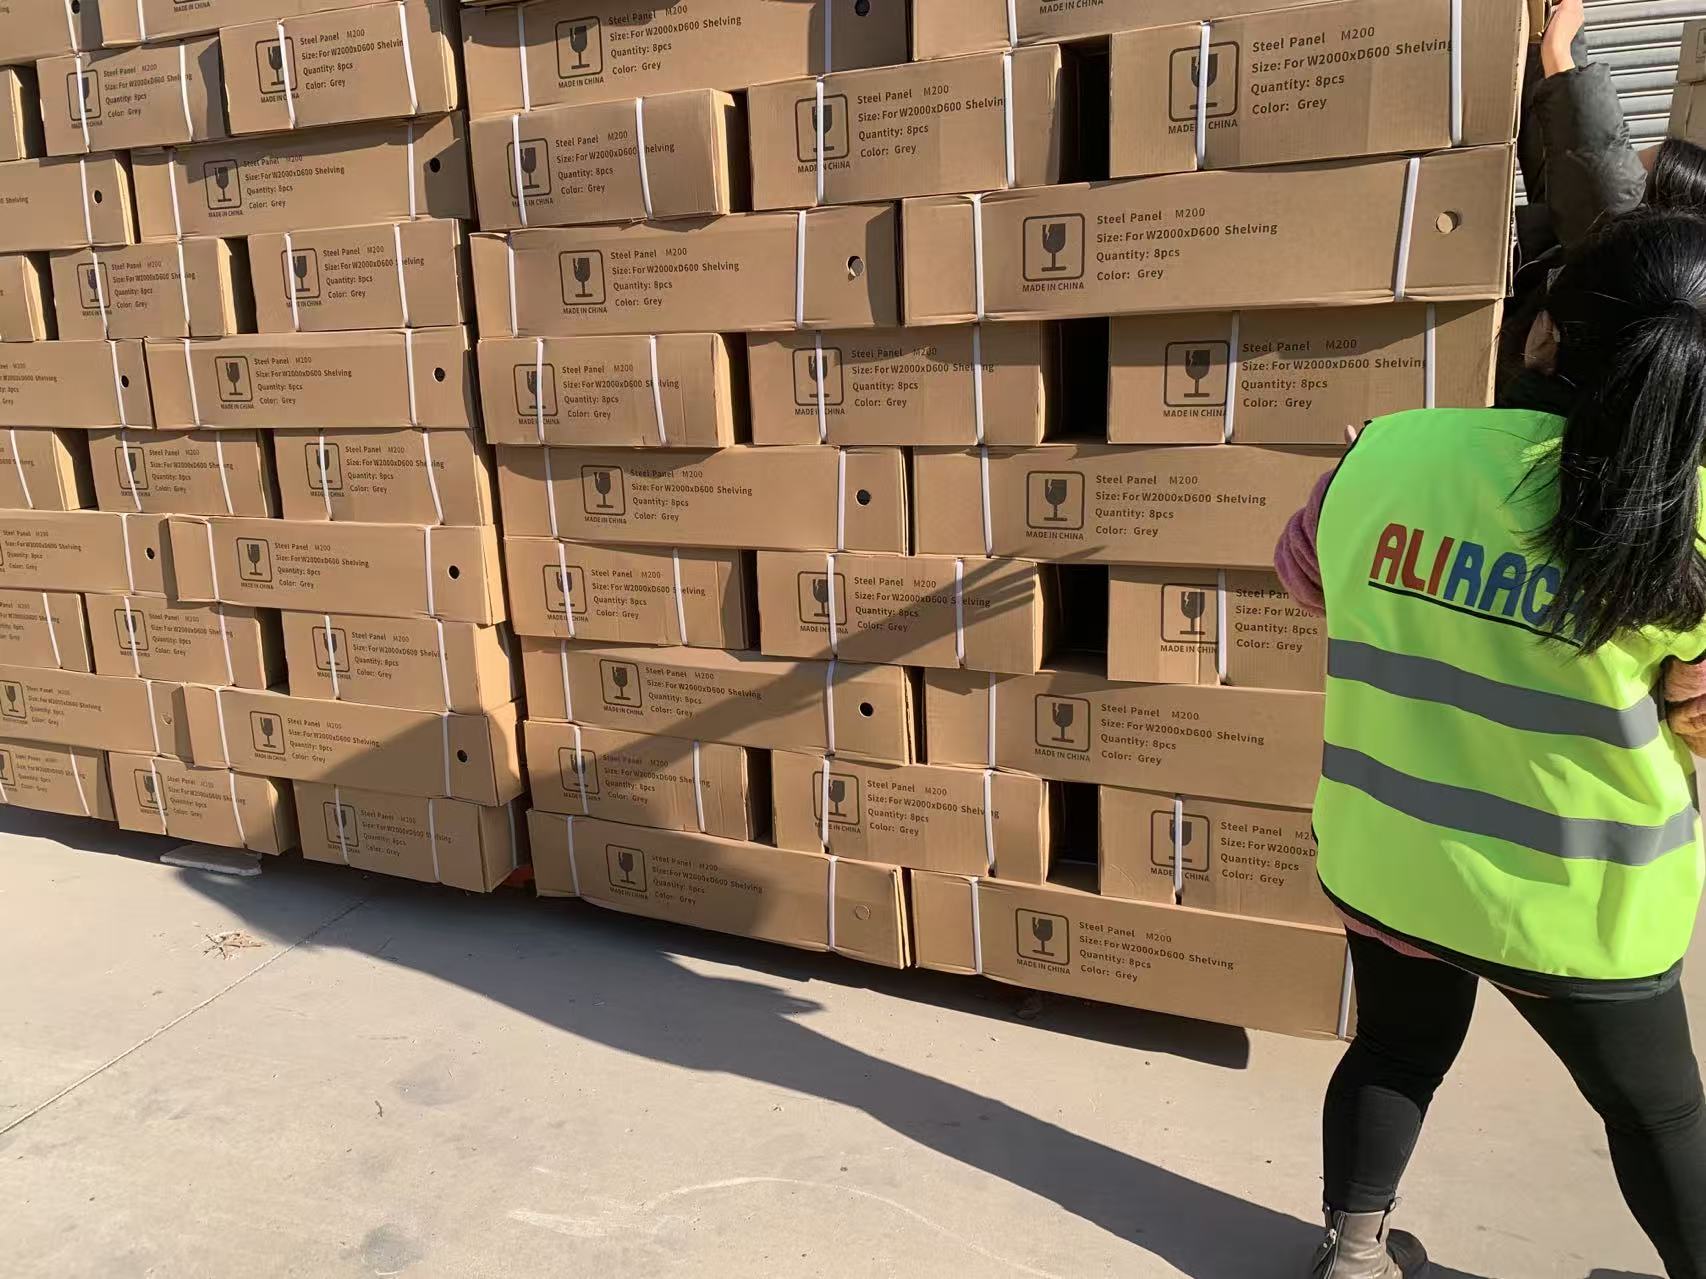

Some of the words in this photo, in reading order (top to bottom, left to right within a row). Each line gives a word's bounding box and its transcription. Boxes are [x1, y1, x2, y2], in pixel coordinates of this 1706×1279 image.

[1040, 4, 1063, 14] MADE
[1066, 2, 1074, 10] IN
[1076, 0, 1104, 8] CHINA
[609, 13, 630, 25] Steel
[632, 10, 656, 22] Panel
[665, 5, 687, 16] M200
[703, 16, 741, 28] Shelving
[300, 35, 318, 45] Steel
[320, 32, 339, 43] Panel
[1253, 37, 1284, 53] Steel
[1289, 32, 1325, 48] Panel
[1341, 26, 1375, 40] M200
[611, 45, 650, 59] Quantity:
[652, 43, 672, 53] 8pcs
[1307, 46, 1389, 66] W2000xD600
[303, 65, 335, 77] Quantity:
[337, 63, 353, 72] 8pcs
[612, 65, 637, 75] Color:
[641, 62, 661, 71] Grey
[306, 81, 326, 90] Color:
[330, 79, 345, 87] Grey
[558, 80, 576, 88] MADE
[584, 76, 604, 86] CHINA
[1251, 79, 1310, 96] Quantity:
[1315, 75, 1344, 88] 8pcs
[1252, 102, 1289, 115] Color:
[1298, 98, 1327, 110] Grey
[1168, 123, 1194, 134] MADE
[1208, 118, 1237, 130] CHINA
[1097, 213, 1125, 225] Steel
[1130, 210, 1162, 222] Panel
[1175, 208, 1205, 218] M200
[1146, 226, 1220, 240] W2000xD600
[1225, 224, 1278, 235] Shelving
[611, 250, 631, 260] Steel
[634, 249, 657, 258] Panel
[666, 248, 687, 256] M200
[1096, 250, 1149, 263] Quantity:
[1154, 248, 1180, 260] 8pcs
[702, 262, 739, 272] Shelving
[1097, 270, 1130, 281] Color:
[1137, 269, 1164, 280] Grey
[613, 281, 651, 292] Quantity:
[654, 281, 672, 291] 8pcs
[1022, 283, 1045, 292] MADE
[1047, 283, 1056, 291] IN
[1058, 282, 1084, 291] CHINA
[615, 298, 639, 306] Color:
[643, 297, 662, 307] Grey
[630, 469, 650, 477] Steel
[652, 470, 674, 478] Panel
[1096, 474, 1123, 484] Steel
[1127, 475, 1157, 484] Panel
[1169, 476, 1198, 484] M200
[716, 486, 753, 497] Shelving
[633, 497, 668, 507] Quantity:
[671, 499, 689, 508] 8pcs
[1141, 492, 1211, 503] W2000xD600
[1216, 493, 1267, 506] Shelving
[634, 512, 657, 520] Color:
[661, 513, 679, 522] Grey
[1095, 508, 1145, 520] Quantity:
[1149, 509, 1174, 520] 8pcs
[1095, 526, 1126, 535] Color:
[1134, 527, 1158, 538] Grey
[1369, 523, 1577, 635] ALIRAC
[645, 667, 664, 675] Steel
[666, 669, 687, 678] Panel
[695, 672, 714, 680] M200
[649, 692, 682, 704] Quantity:
[685, 696, 702, 705] 8pcs
[728, 688, 762, 701] Shelving
[650, 705, 672, 714] Color:
[676, 708, 693, 718] Grey
[1101, 704, 1127, 714] Steel
[1131, 706, 1159, 717] Panel
[1172, 711, 1199, 721] M200
[1145, 723, 1212, 739] W2000xD600
[1216, 731, 1265, 746] Shelving
[1101, 734, 1148, 748] Quantity:
[1152, 740, 1176, 750] 8pcs
[1035, 748, 1055, 757] MADE
[1066, 752, 1090, 761] CHINA
[1101, 750, 1131, 761] Color:
[1138, 754, 1162, 766] Grey
[1079, 921, 1104, 933] Steel
[1107, 926, 1135, 938] Panel
[1146, 932, 1172, 943] M200
[1080, 949, 1125, 965] Quantity:
[1129, 958, 1151, 969] 8pcs
[1121, 942, 1185, 961] W2000xD600
[1188, 954, 1234, 970] Shelving
[1017, 958, 1036, 968] MADE
[1047, 965, 1070, 974] CHINA
[1081, 964, 1109, 976] Color:
[1115, 971, 1138, 983] Grey
